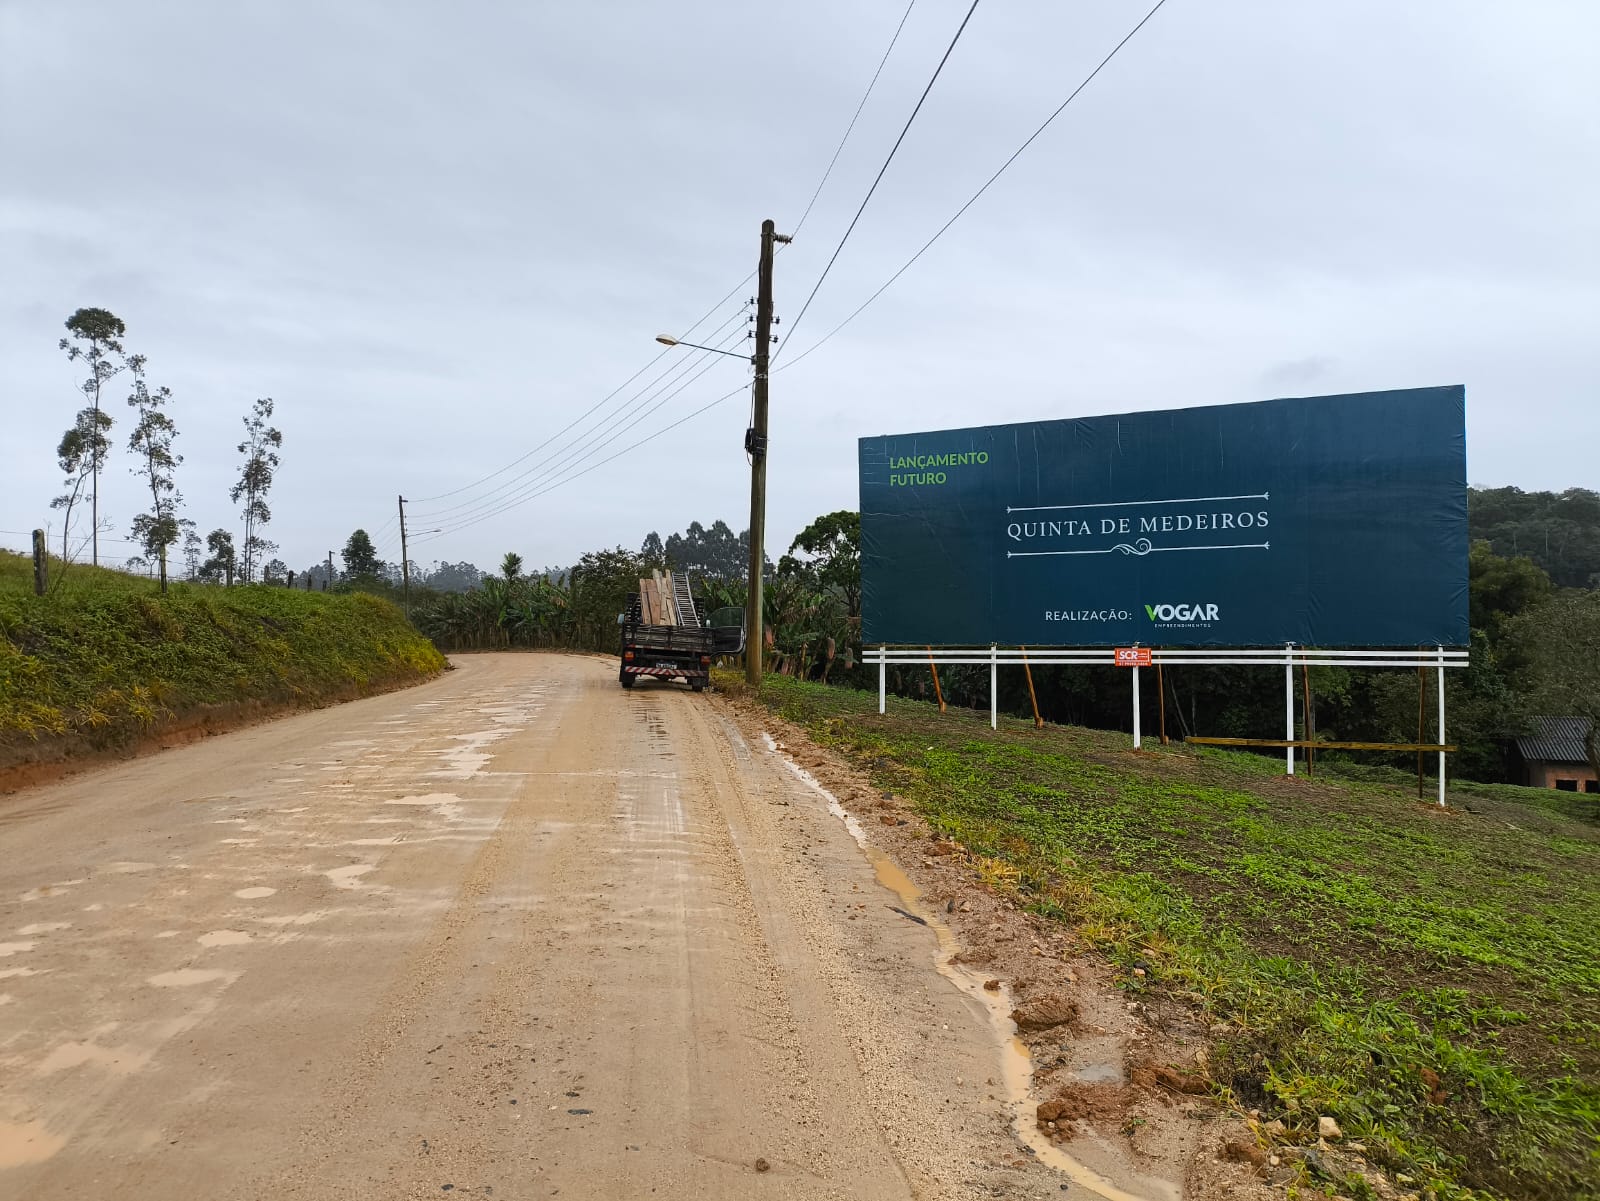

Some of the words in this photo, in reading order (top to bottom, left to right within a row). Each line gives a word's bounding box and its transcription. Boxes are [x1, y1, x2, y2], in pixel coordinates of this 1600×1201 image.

[889, 451, 989, 470] LANÇAMENTO
[890, 472, 947, 487] FUTURO
[1007, 520, 1092, 542] QUINTA
[1100, 518, 1131, 535] DE
[1139, 511, 1270, 533] MEDEIROS
[1045, 608, 1133, 622] REALIZAÇÃO:
[1144, 603, 1220, 621] VOGAR
[1119, 651, 1138, 660] SCR
